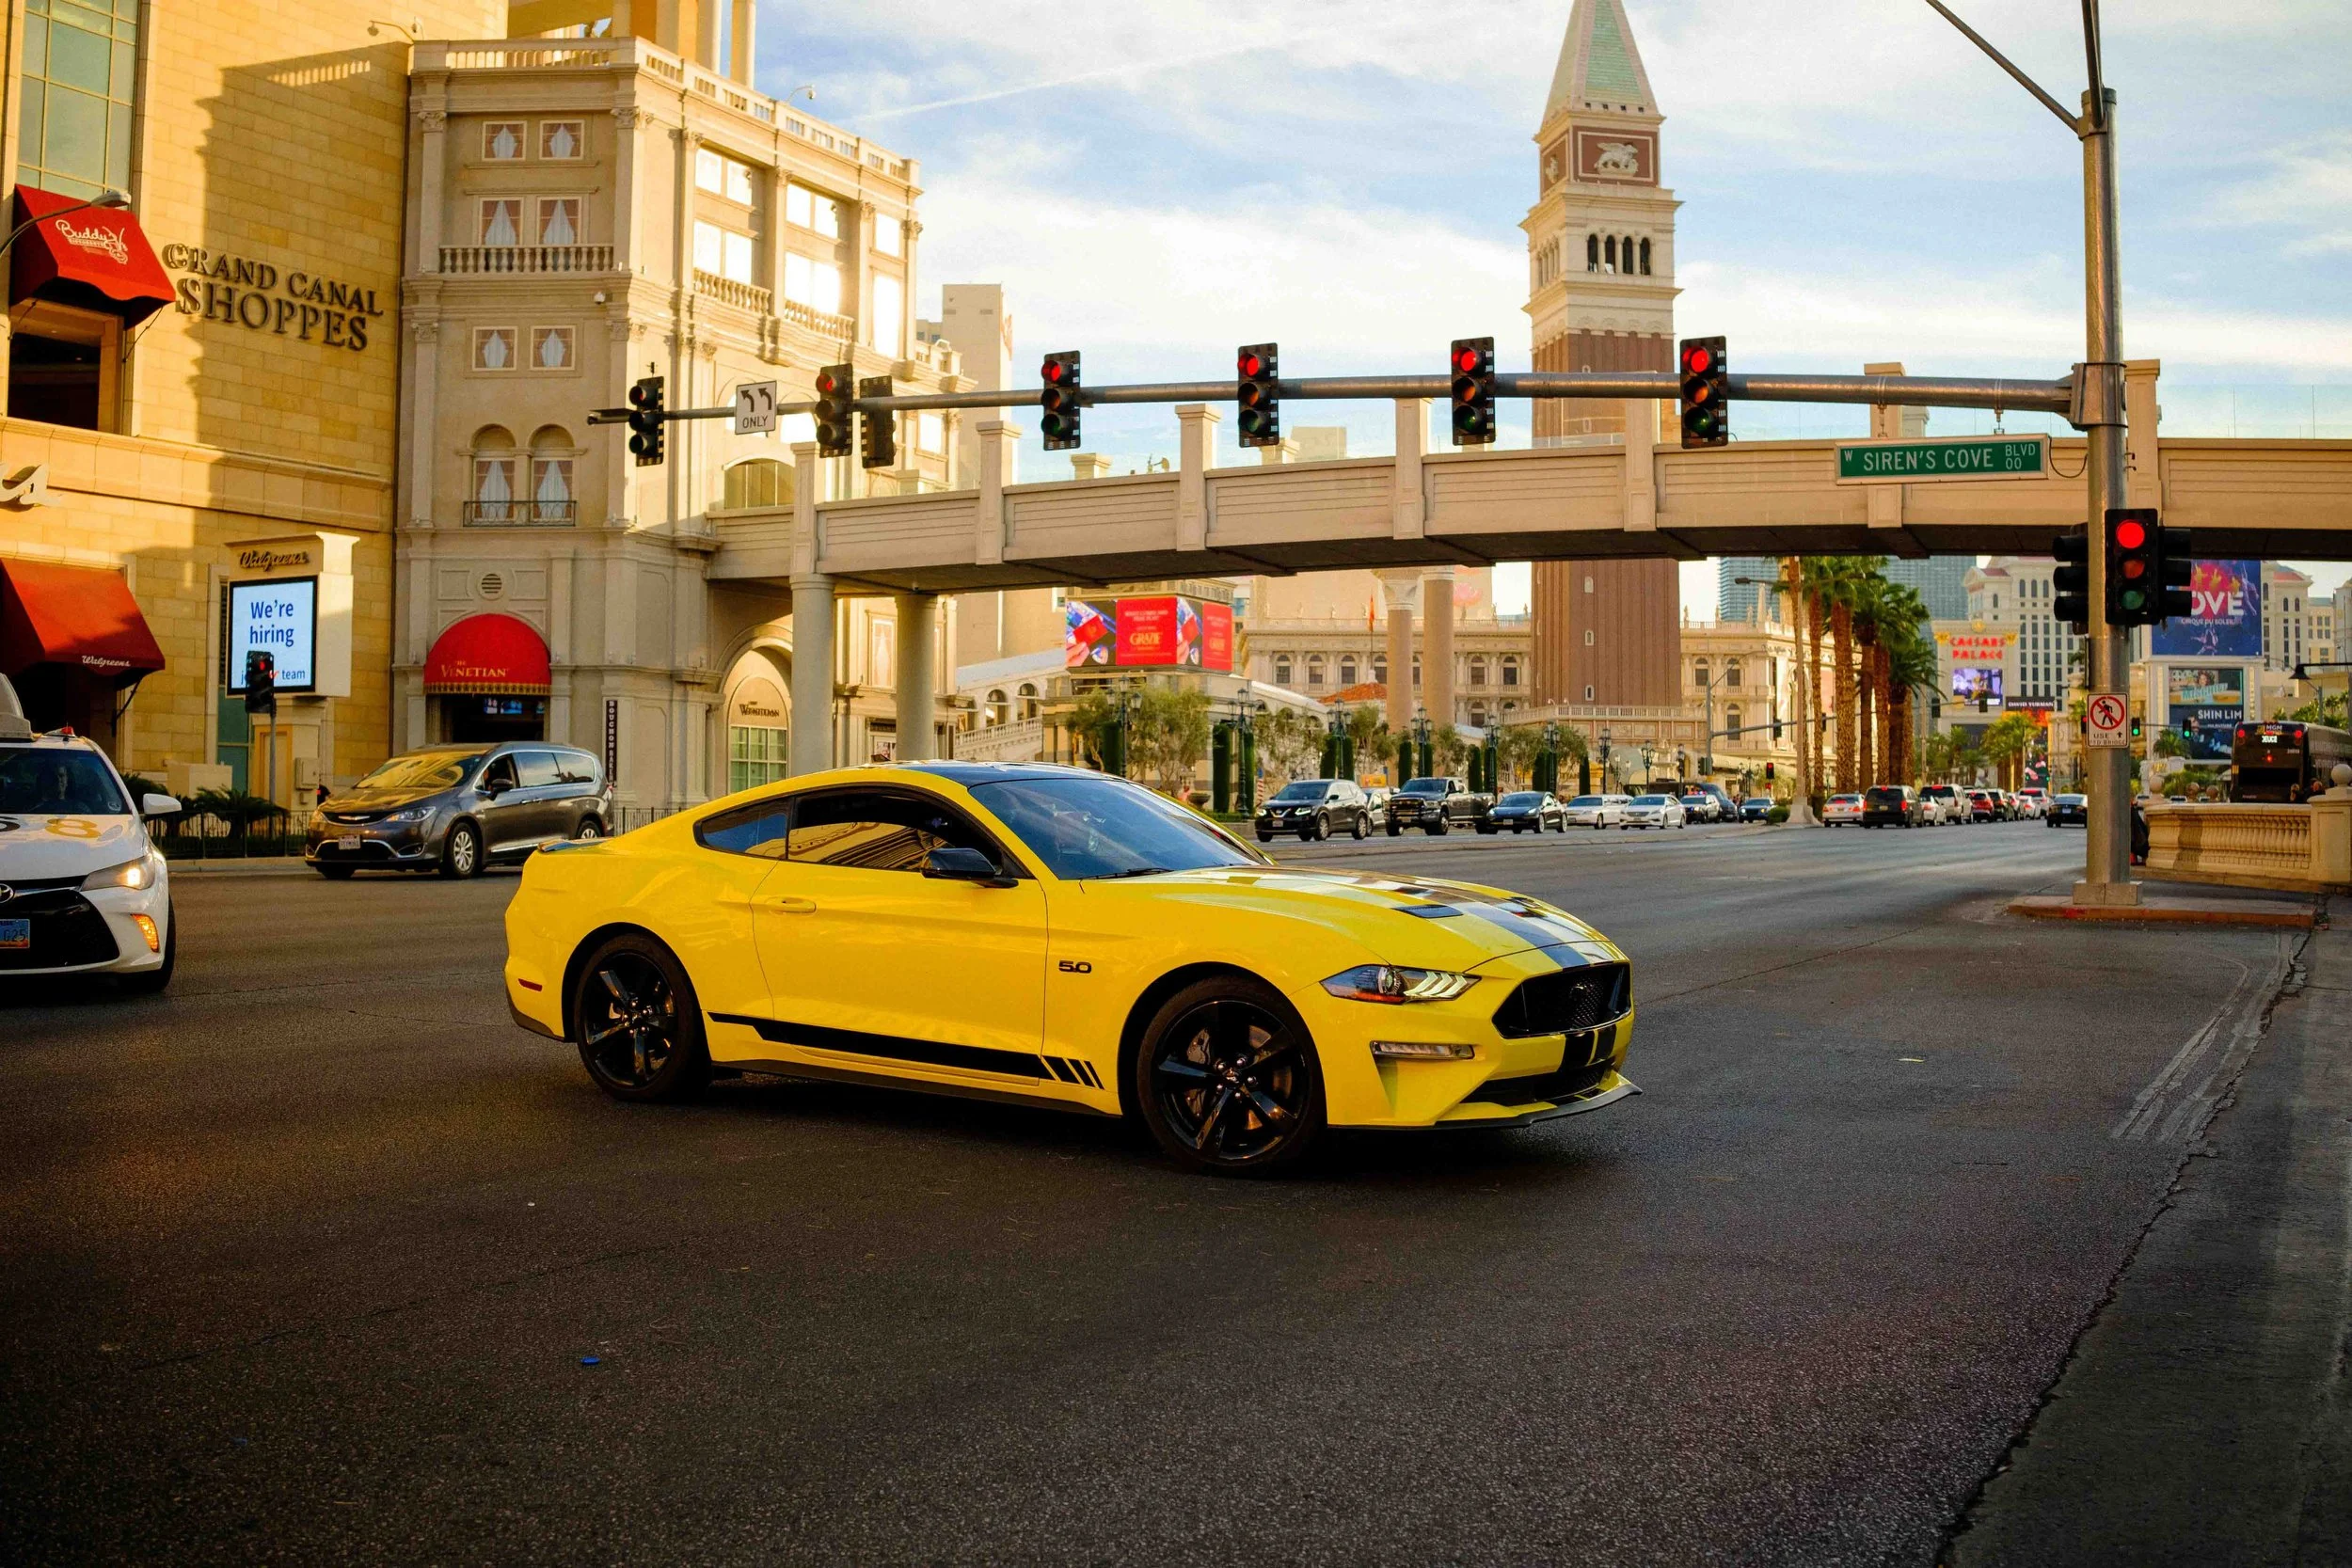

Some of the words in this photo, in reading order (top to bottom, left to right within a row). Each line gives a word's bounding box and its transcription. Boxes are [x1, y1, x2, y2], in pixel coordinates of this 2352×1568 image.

[56, 220, 108, 244] Buddy
[162, 243, 277, 290] GRAND
[287, 272, 384, 316] CANAL
[176, 277, 368, 351] SHOPPES
[742, 416, 768, 429] ONLY
[1844, 450, 1853, 462] W
[1863, 451, 1936, 471] SIREN'S
[1945, 448, 1994, 468] COVE
[2005, 443, 2036, 457] BLVD
[250, 599, 294, 620] We're
[2190, 590, 2245, 616] OVE
[2182, 617, 2203, 626] CIRQUE
[2215, 617, 2234, 626] SOLEIL
[249, 625, 294, 647] hiring
[1949, 637, 2006, 647] CAESARS
[1952, 649, 2003, 659] PALACE
[82, 656, 131, 668] Walgreens
[281, 670, 306, 680] team
[441, 664, 506, 677] VENETIAN
[2198, 709, 2222, 720] SHIN
[2224, 709, 2242, 720] LIM
[1059, 960, 1092, 974] 5.0
